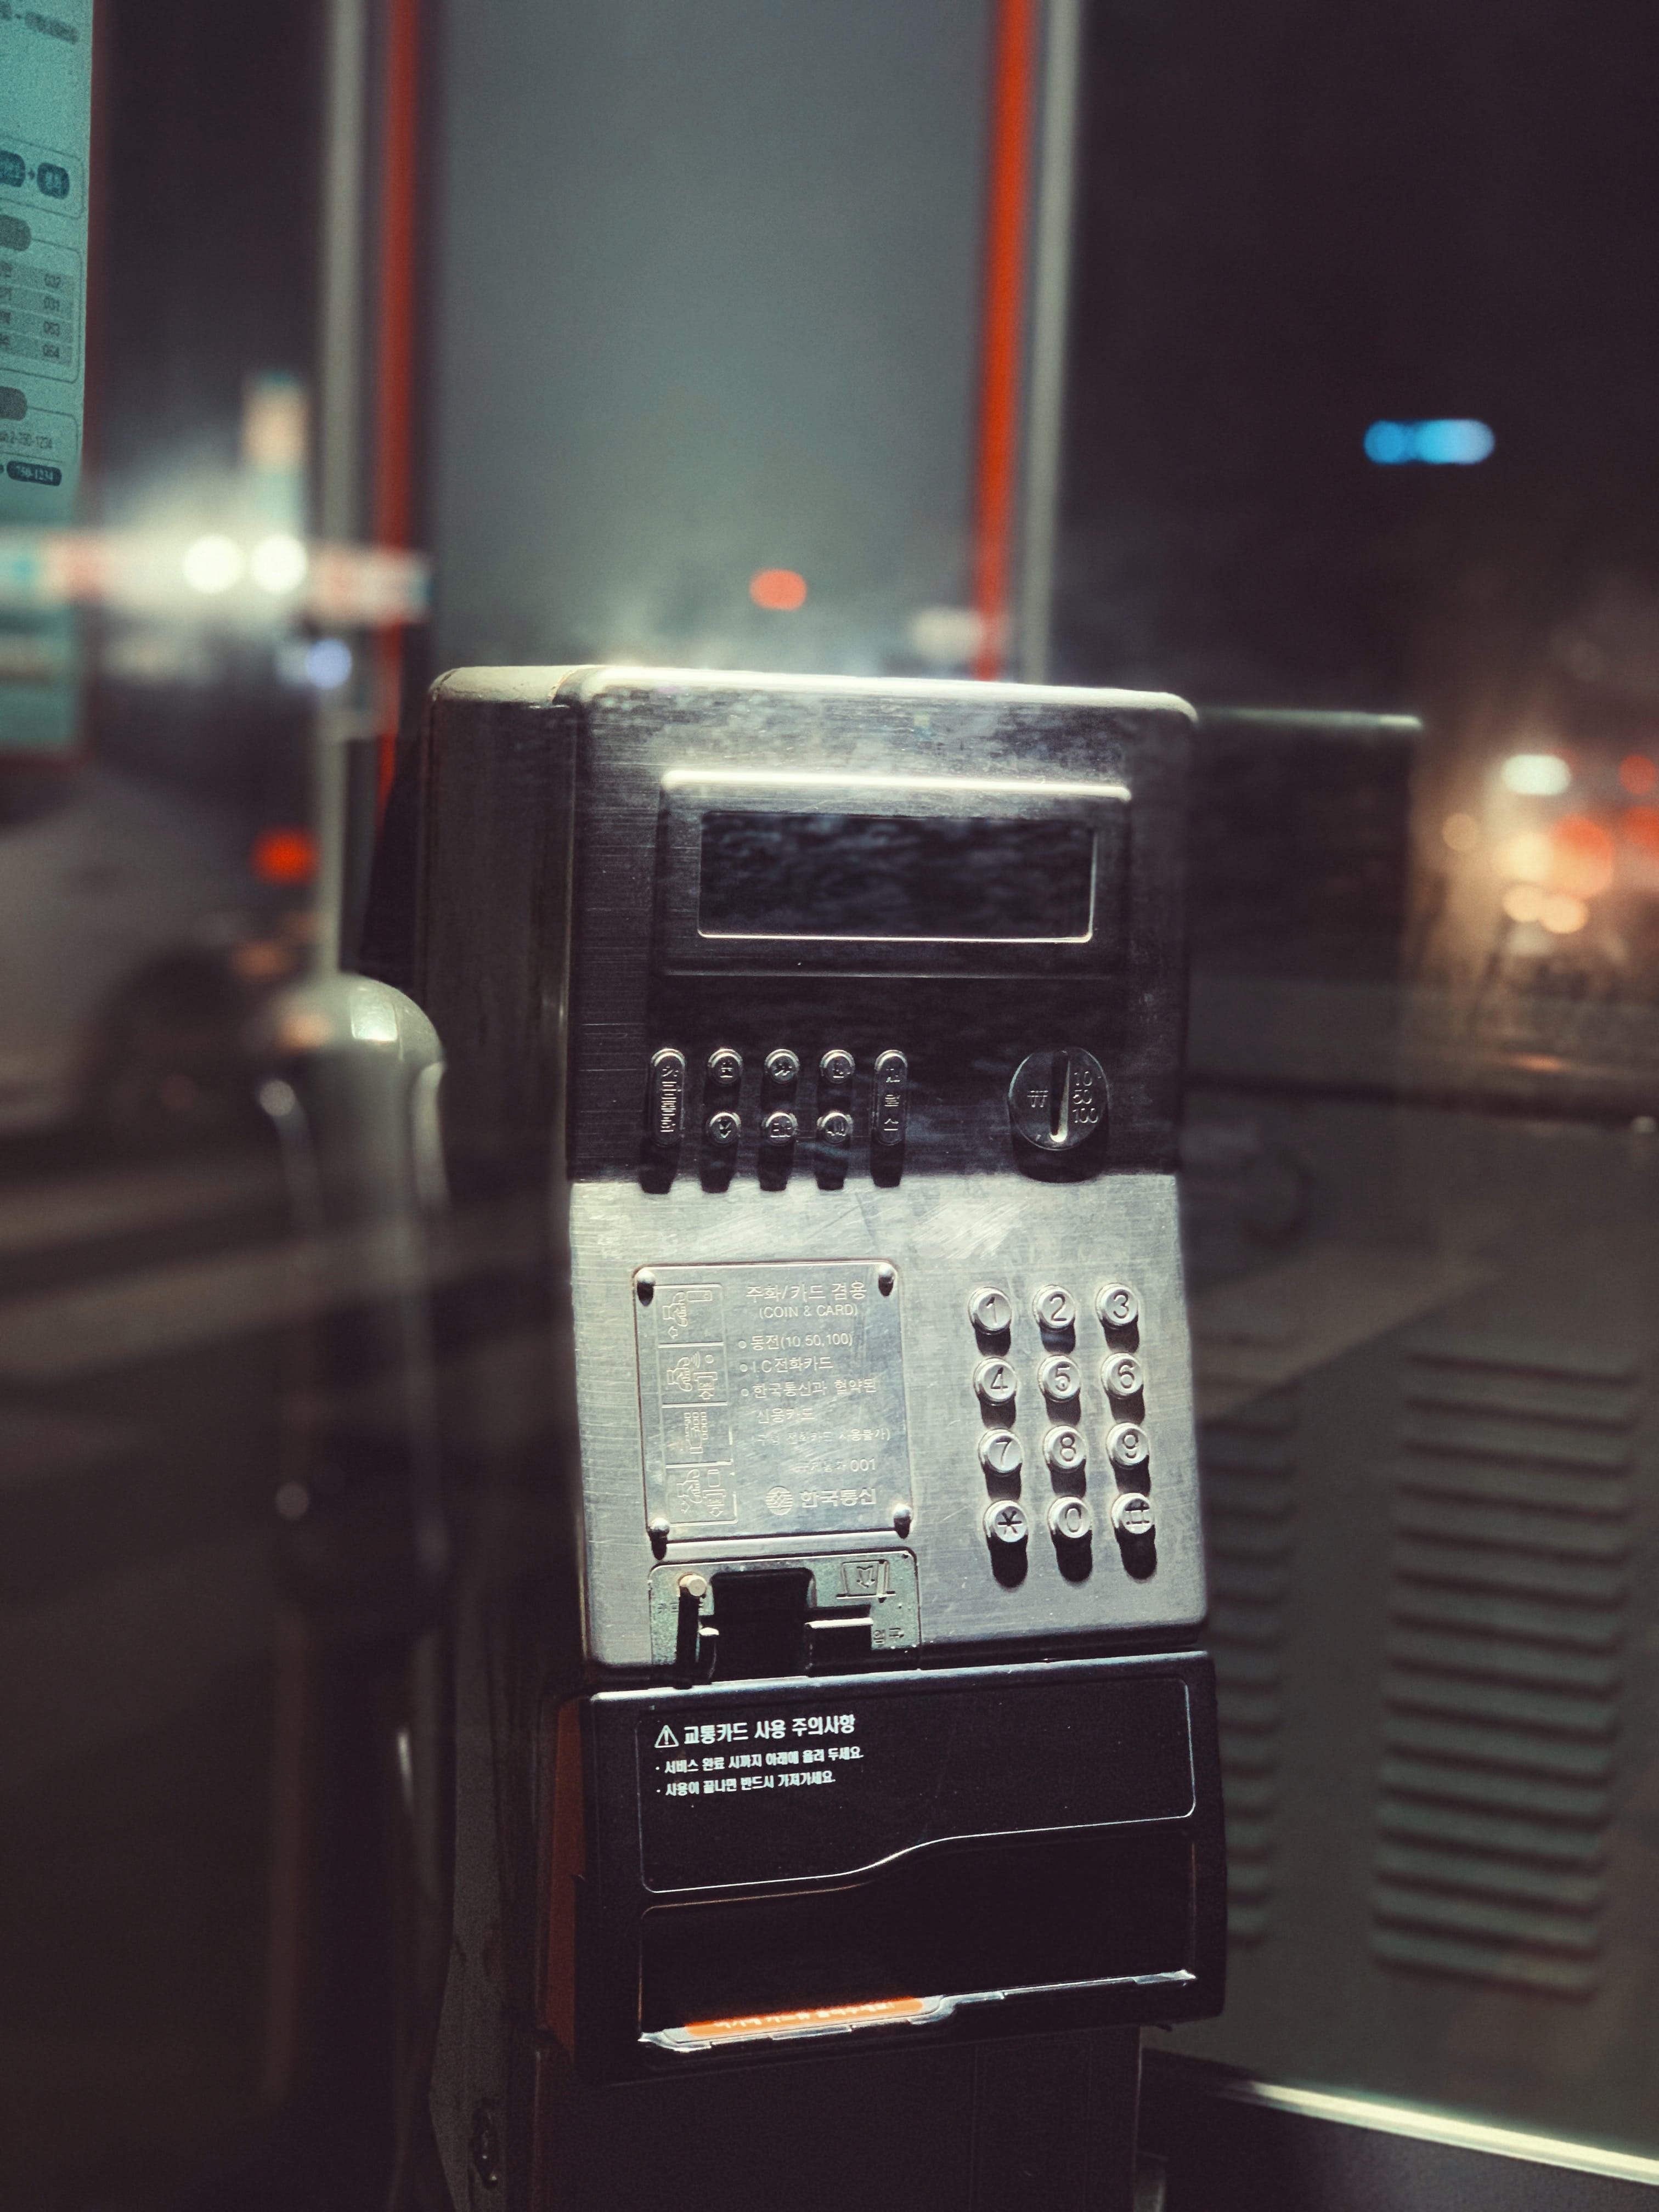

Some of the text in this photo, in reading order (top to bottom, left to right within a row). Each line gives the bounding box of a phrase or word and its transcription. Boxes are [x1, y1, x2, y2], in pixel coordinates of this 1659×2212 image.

[746, 1281, 867, 1303] 주화/카드 겸용
[759, 1304, 859, 1319] (COIN & CARD)
[986, 1291, 1130, 1326] 1 2 3
[990, 1362, 1135, 1394] 4 5 6
[752, 1380, 827, 1399] 한국통신과
[757, 1407, 816, 1424] 신용카드
[995, 1431, 1139, 1466] 7 8 9
[850, 1457, 877, 1472] 001
[799, 1487, 877, 1508] 한국통신
[1064, 1506, 1082, 1533] 0
[684, 1714, 855, 1745] 교통카드 사용 주의사항
[664, 1759, 699, 1774] 서비스
[702, 1757, 725, 1771] 완료
[765, 1751, 799, 1766] 아래에
[665, 1781, 699, 1797] 사용이
[741, 1775, 775, 1791] 반드시
